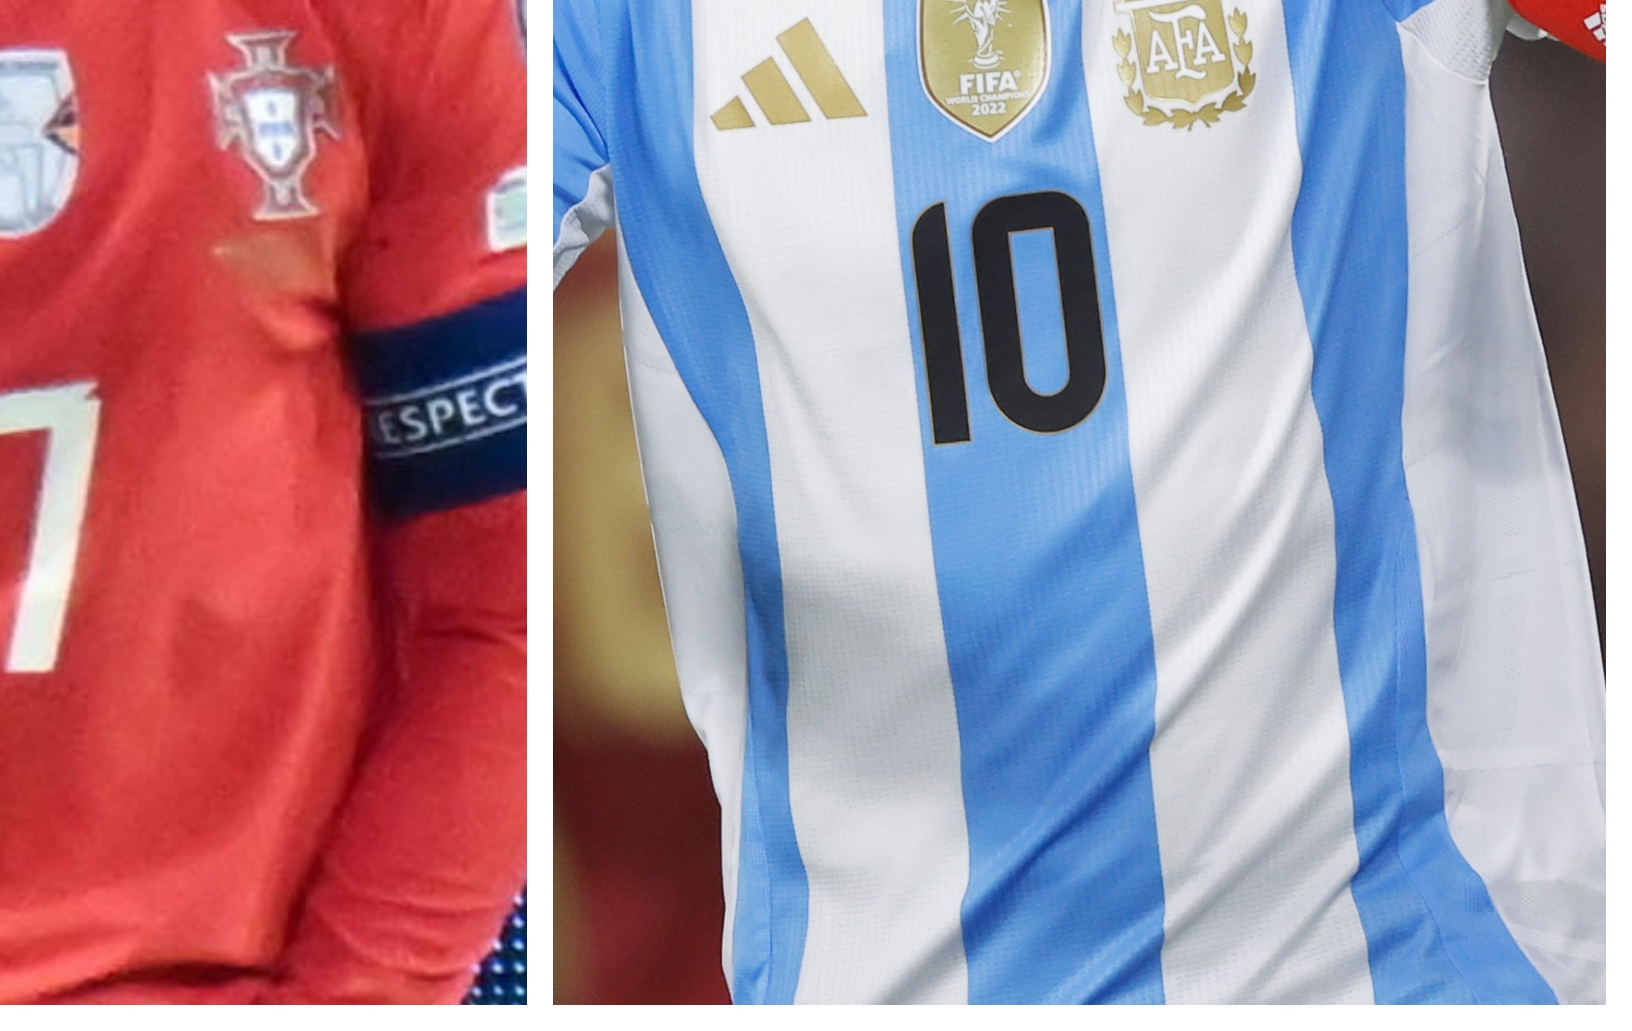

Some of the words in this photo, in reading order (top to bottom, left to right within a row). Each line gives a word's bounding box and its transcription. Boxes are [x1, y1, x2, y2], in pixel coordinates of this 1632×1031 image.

[1146, 4, 1226, 80] AFA
[959, 70, 1019, 95] FIFA
[945, 95, 978, 106] WORLD
[971, 101, 1007, 117] 2022
[910, 189, 1108, 447] 10
